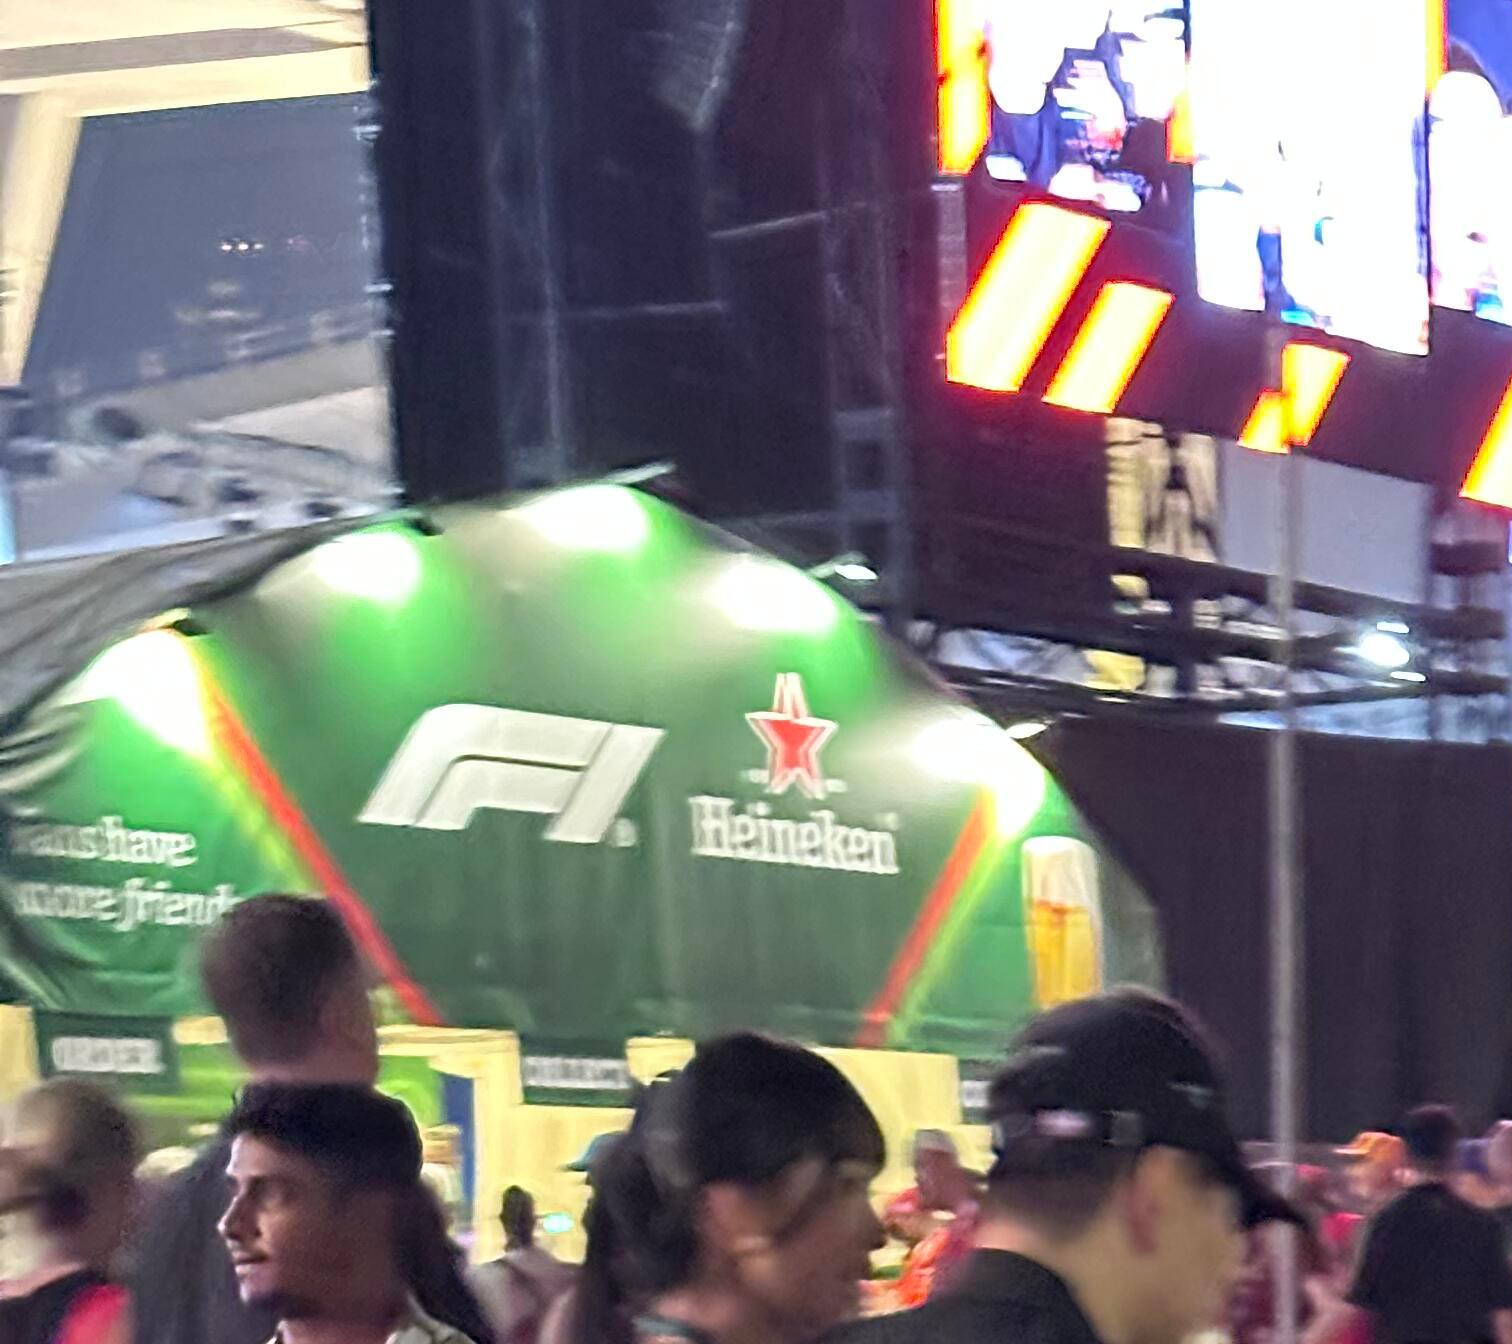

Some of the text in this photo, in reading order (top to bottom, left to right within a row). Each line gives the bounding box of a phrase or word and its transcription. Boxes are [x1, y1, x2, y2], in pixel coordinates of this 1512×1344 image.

[99, 815, 198, 868] have
[688, 796, 899, 874] Heineken
[113, 876, 250, 932] friend
